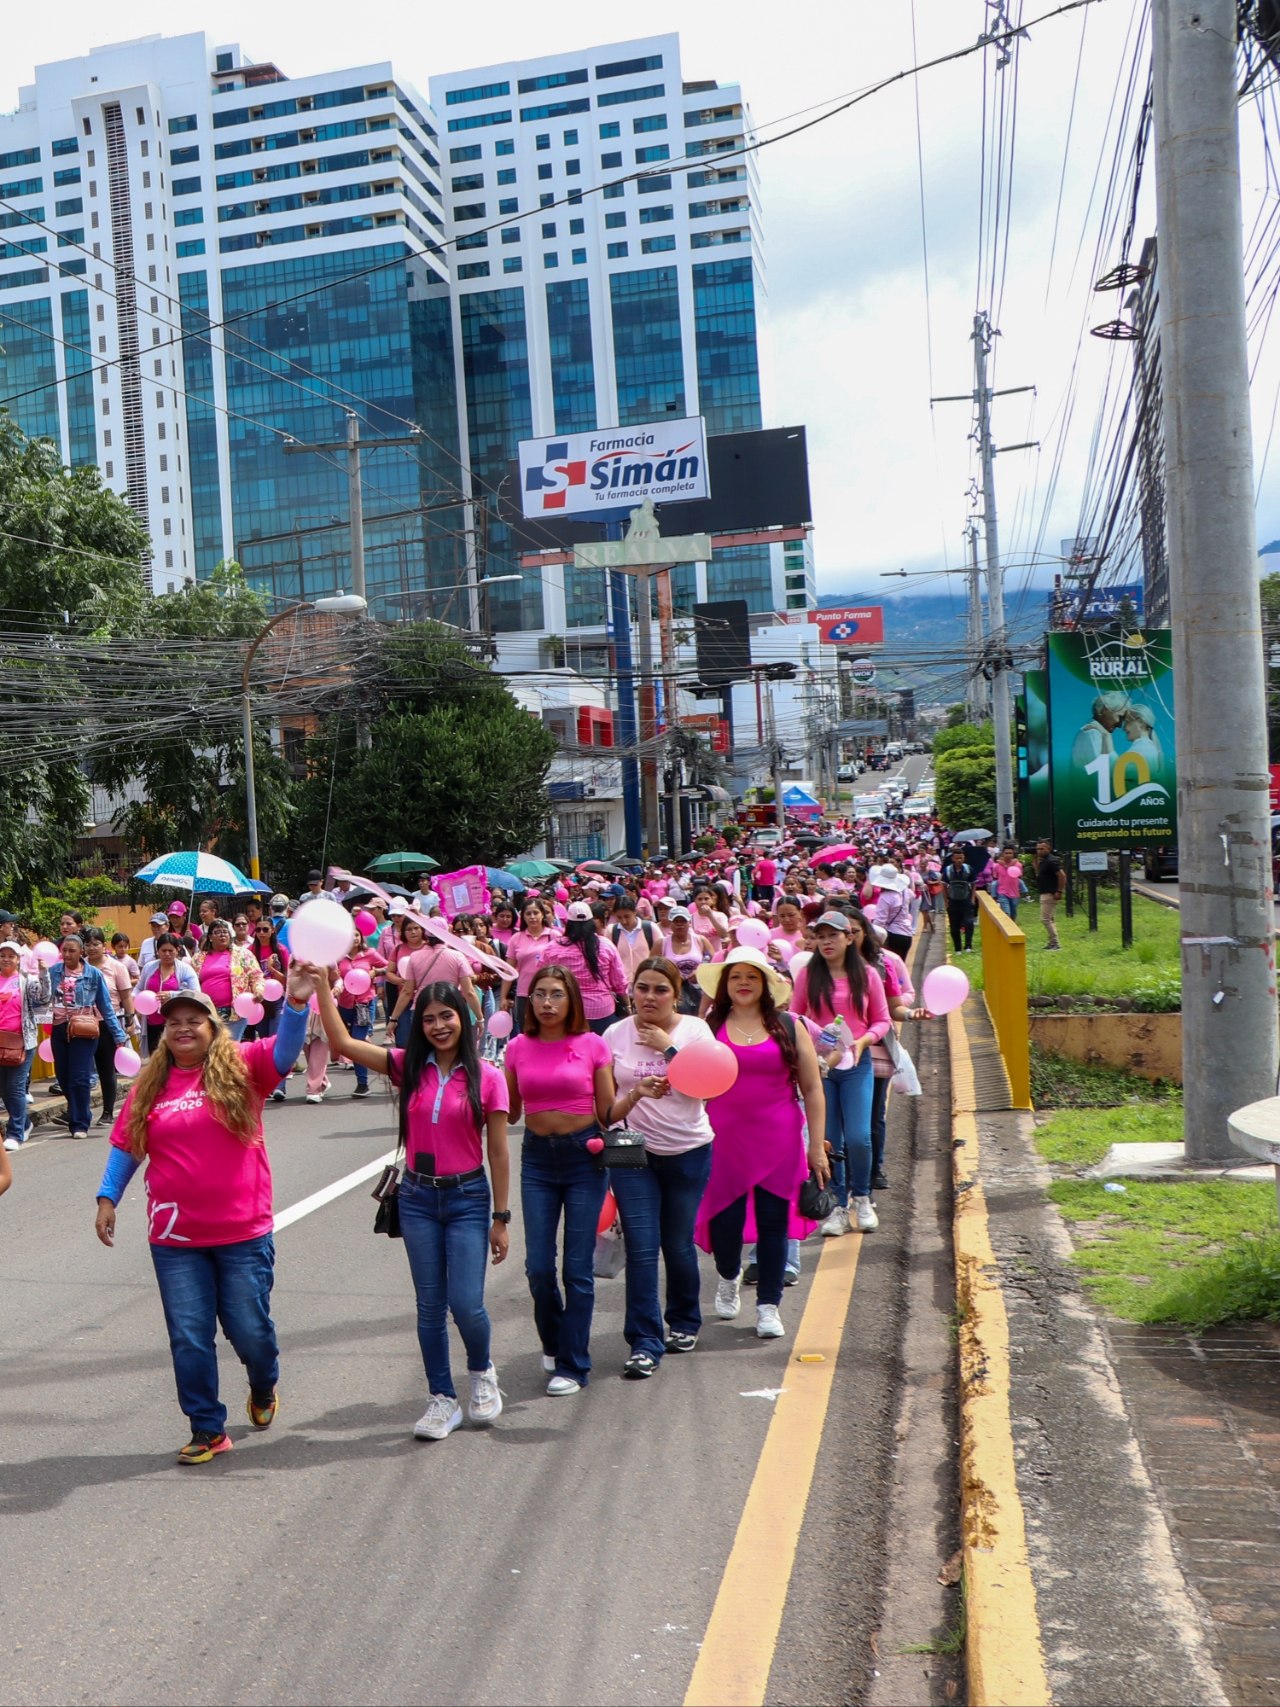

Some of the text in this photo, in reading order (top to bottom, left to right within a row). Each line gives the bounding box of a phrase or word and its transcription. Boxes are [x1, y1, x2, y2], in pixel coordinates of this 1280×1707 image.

[590, 432, 654, 452] Farmacia
[590, 450, 699, 490] Simán
[595, 482, 695, 501] Tu farmacia completa
[816, 612, 872, 621] Punto Farma
[1090, 661, 1147, 676] RURAL
[1084, 751, 1151, 804] 10
[1140, 796, 1165, 806] AÑOS
[1077, 817, 1168, 827] Cuidando tu presente
[1077, 827, 1172, 840] asegurando tu futuro
[172, 1098, 203, 1112] 2026
